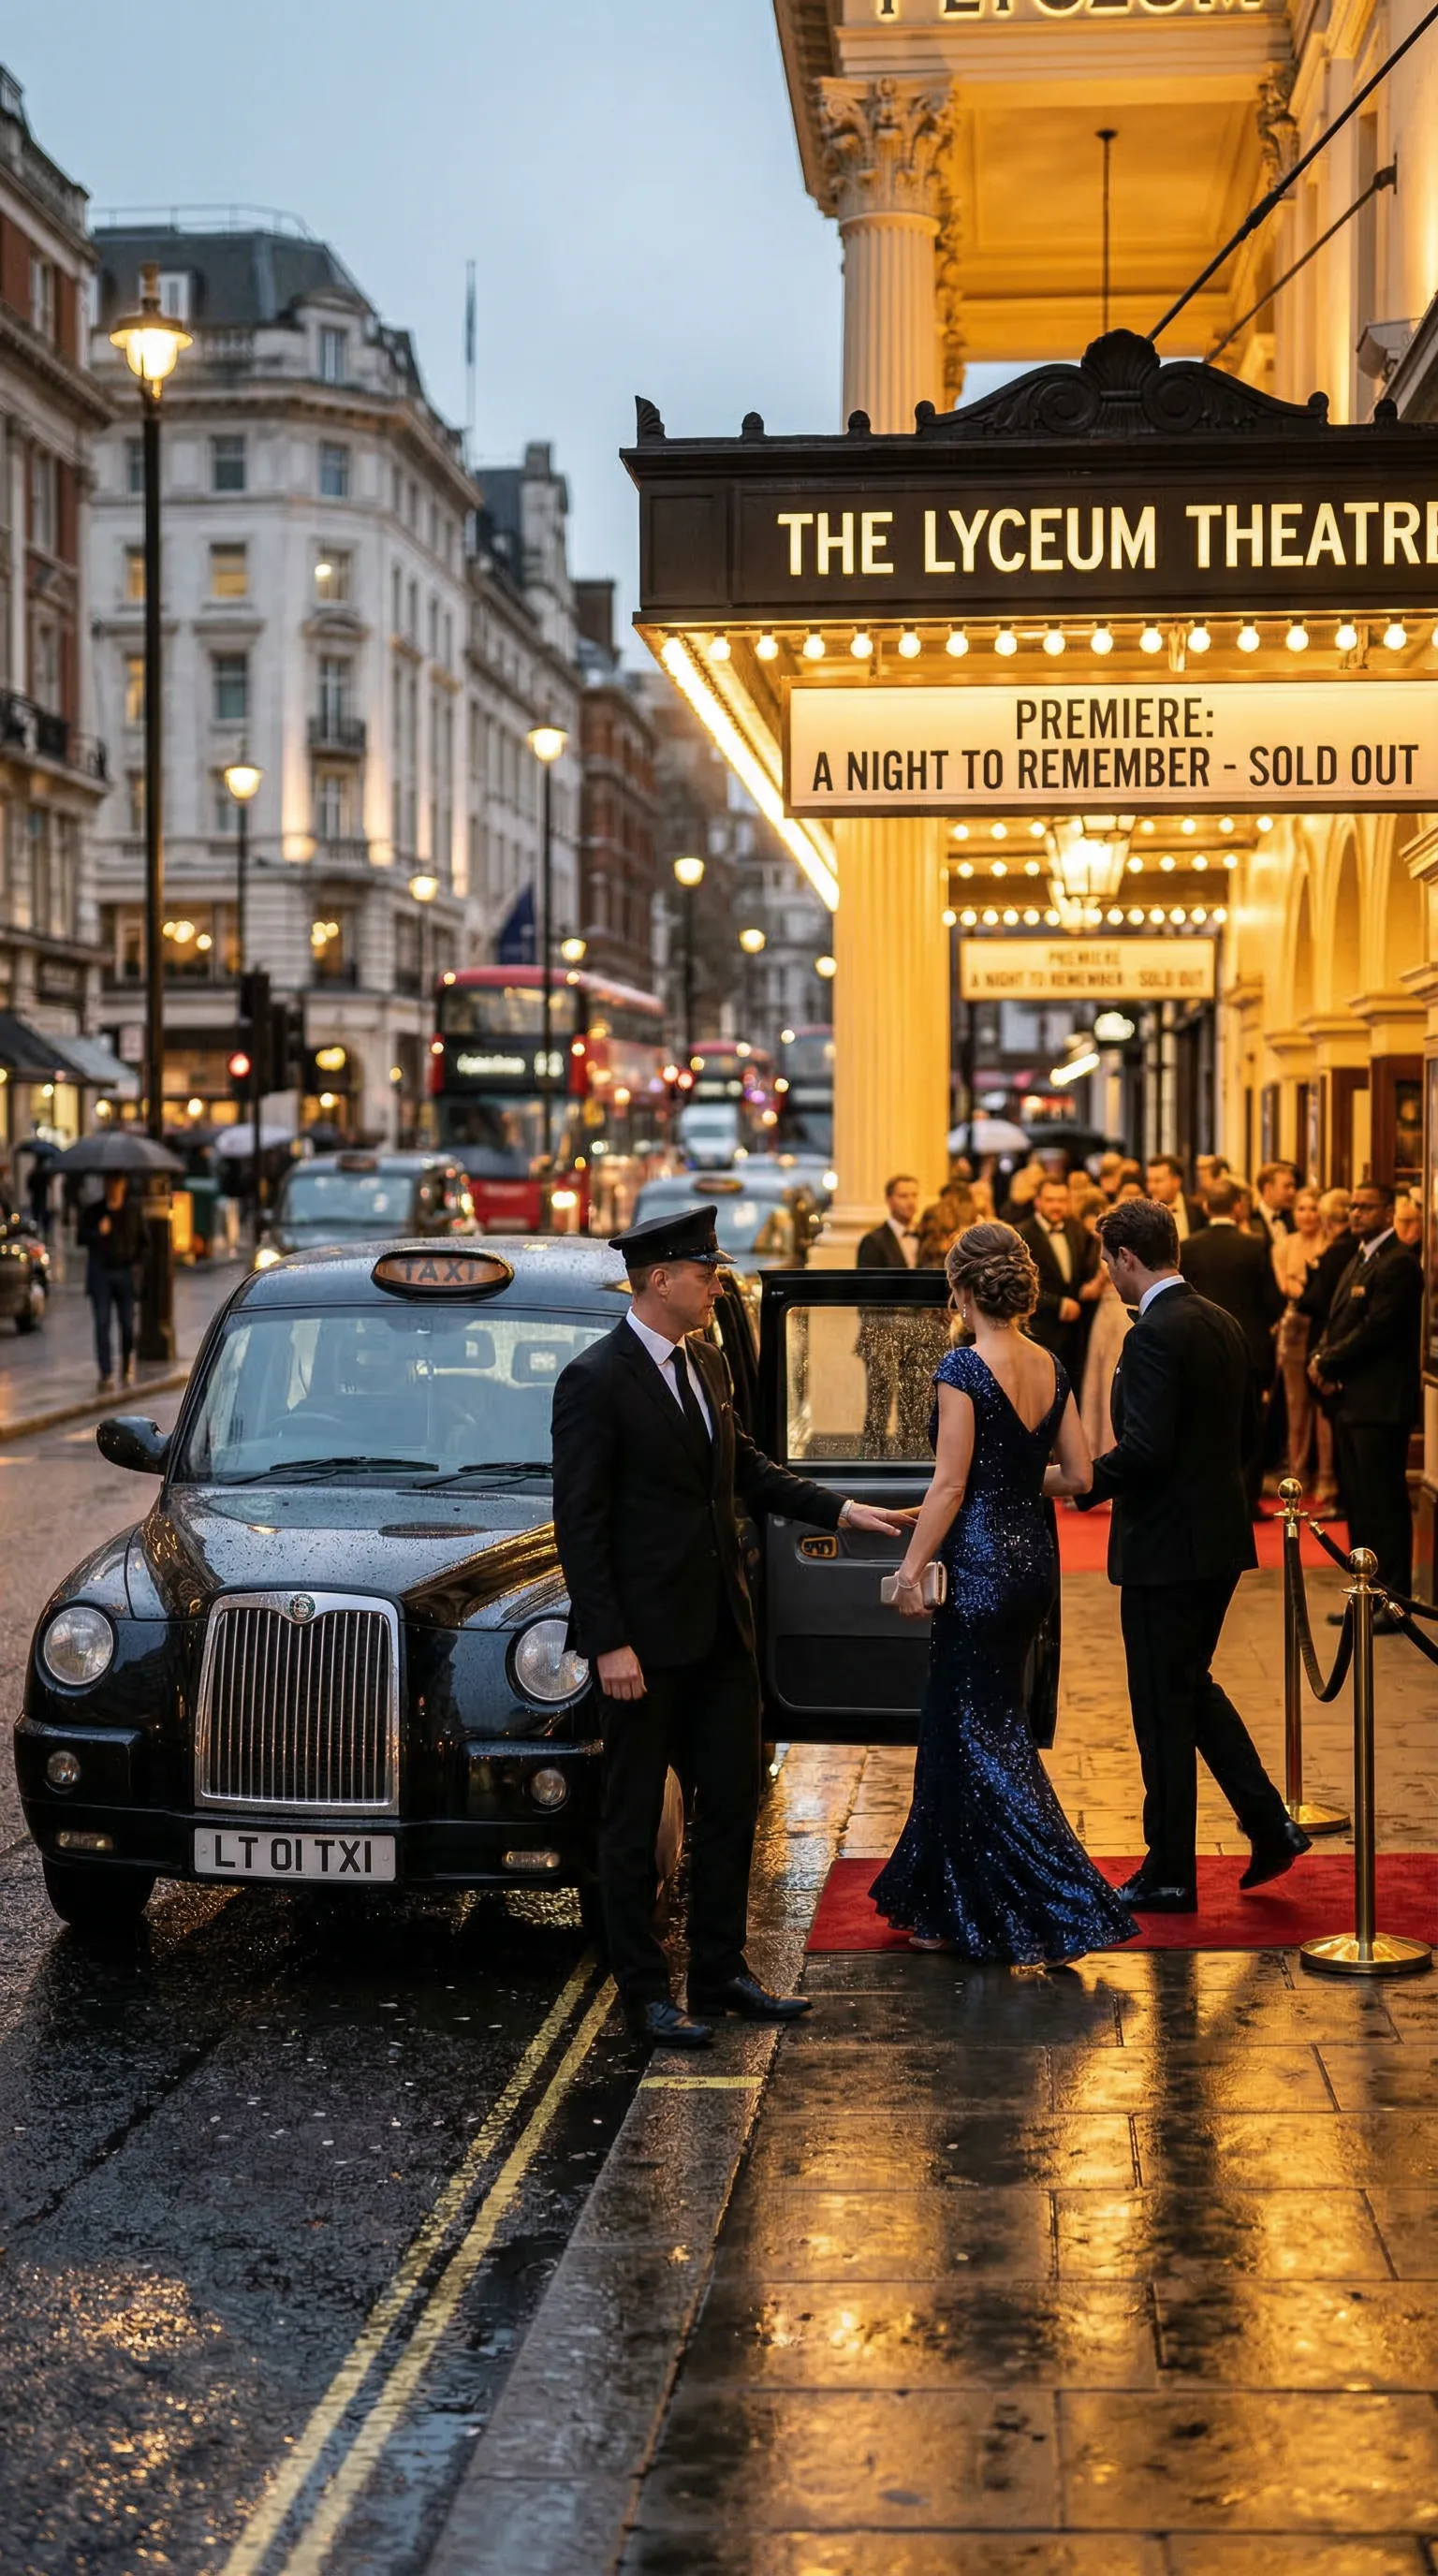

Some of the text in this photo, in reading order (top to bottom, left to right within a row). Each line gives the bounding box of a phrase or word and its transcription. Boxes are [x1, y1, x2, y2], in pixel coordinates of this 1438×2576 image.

[777, 511, 894, 576] THE
[924, 505, 1156, 573] LYCEUM
[1017, 697, 1214, 740] PREMIERE:
[812, 752, 833, 792] A
[847, 750, 949, 791] NIGHT
[961, 749, 1004, 790] TO
[1018, 747, 1210, 789] REMEMBER
[1249, 745, 1337, 787] SOLD
[1351, 744, 1419, 786] OUT
[399, 1257, 477, 1282] TAXI
[214, 1834, 258, 1869] LT
